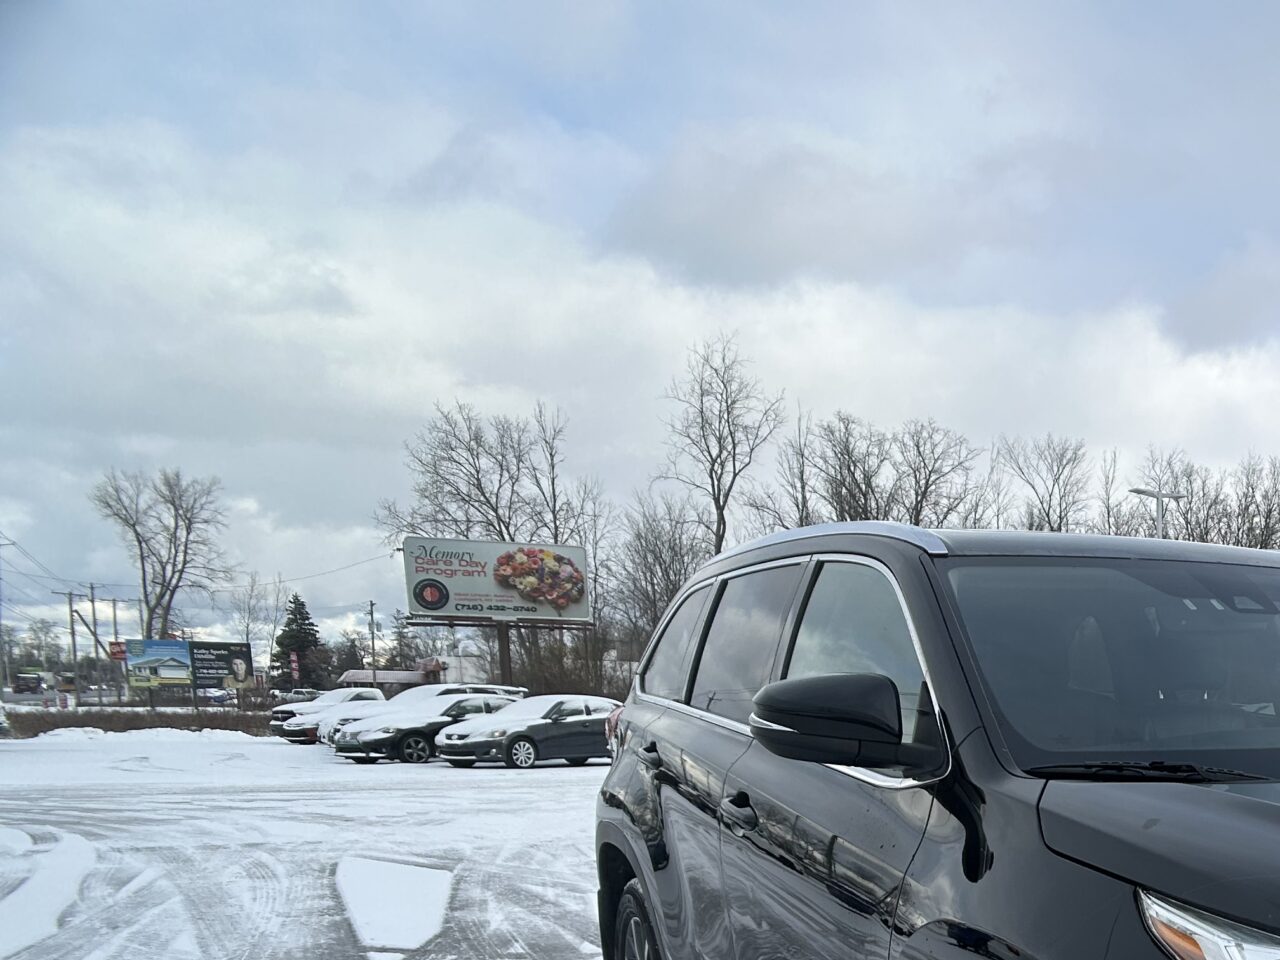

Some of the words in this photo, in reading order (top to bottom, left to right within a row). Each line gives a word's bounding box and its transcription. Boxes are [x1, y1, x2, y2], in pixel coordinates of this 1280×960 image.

[409, 545, 474, 560] Memory
[414, 556, 453, 566] Care
[458, 559, 488, 571] Day
[415, 566, 487, 578] Program
[454, 603, 484, 612] (716)
